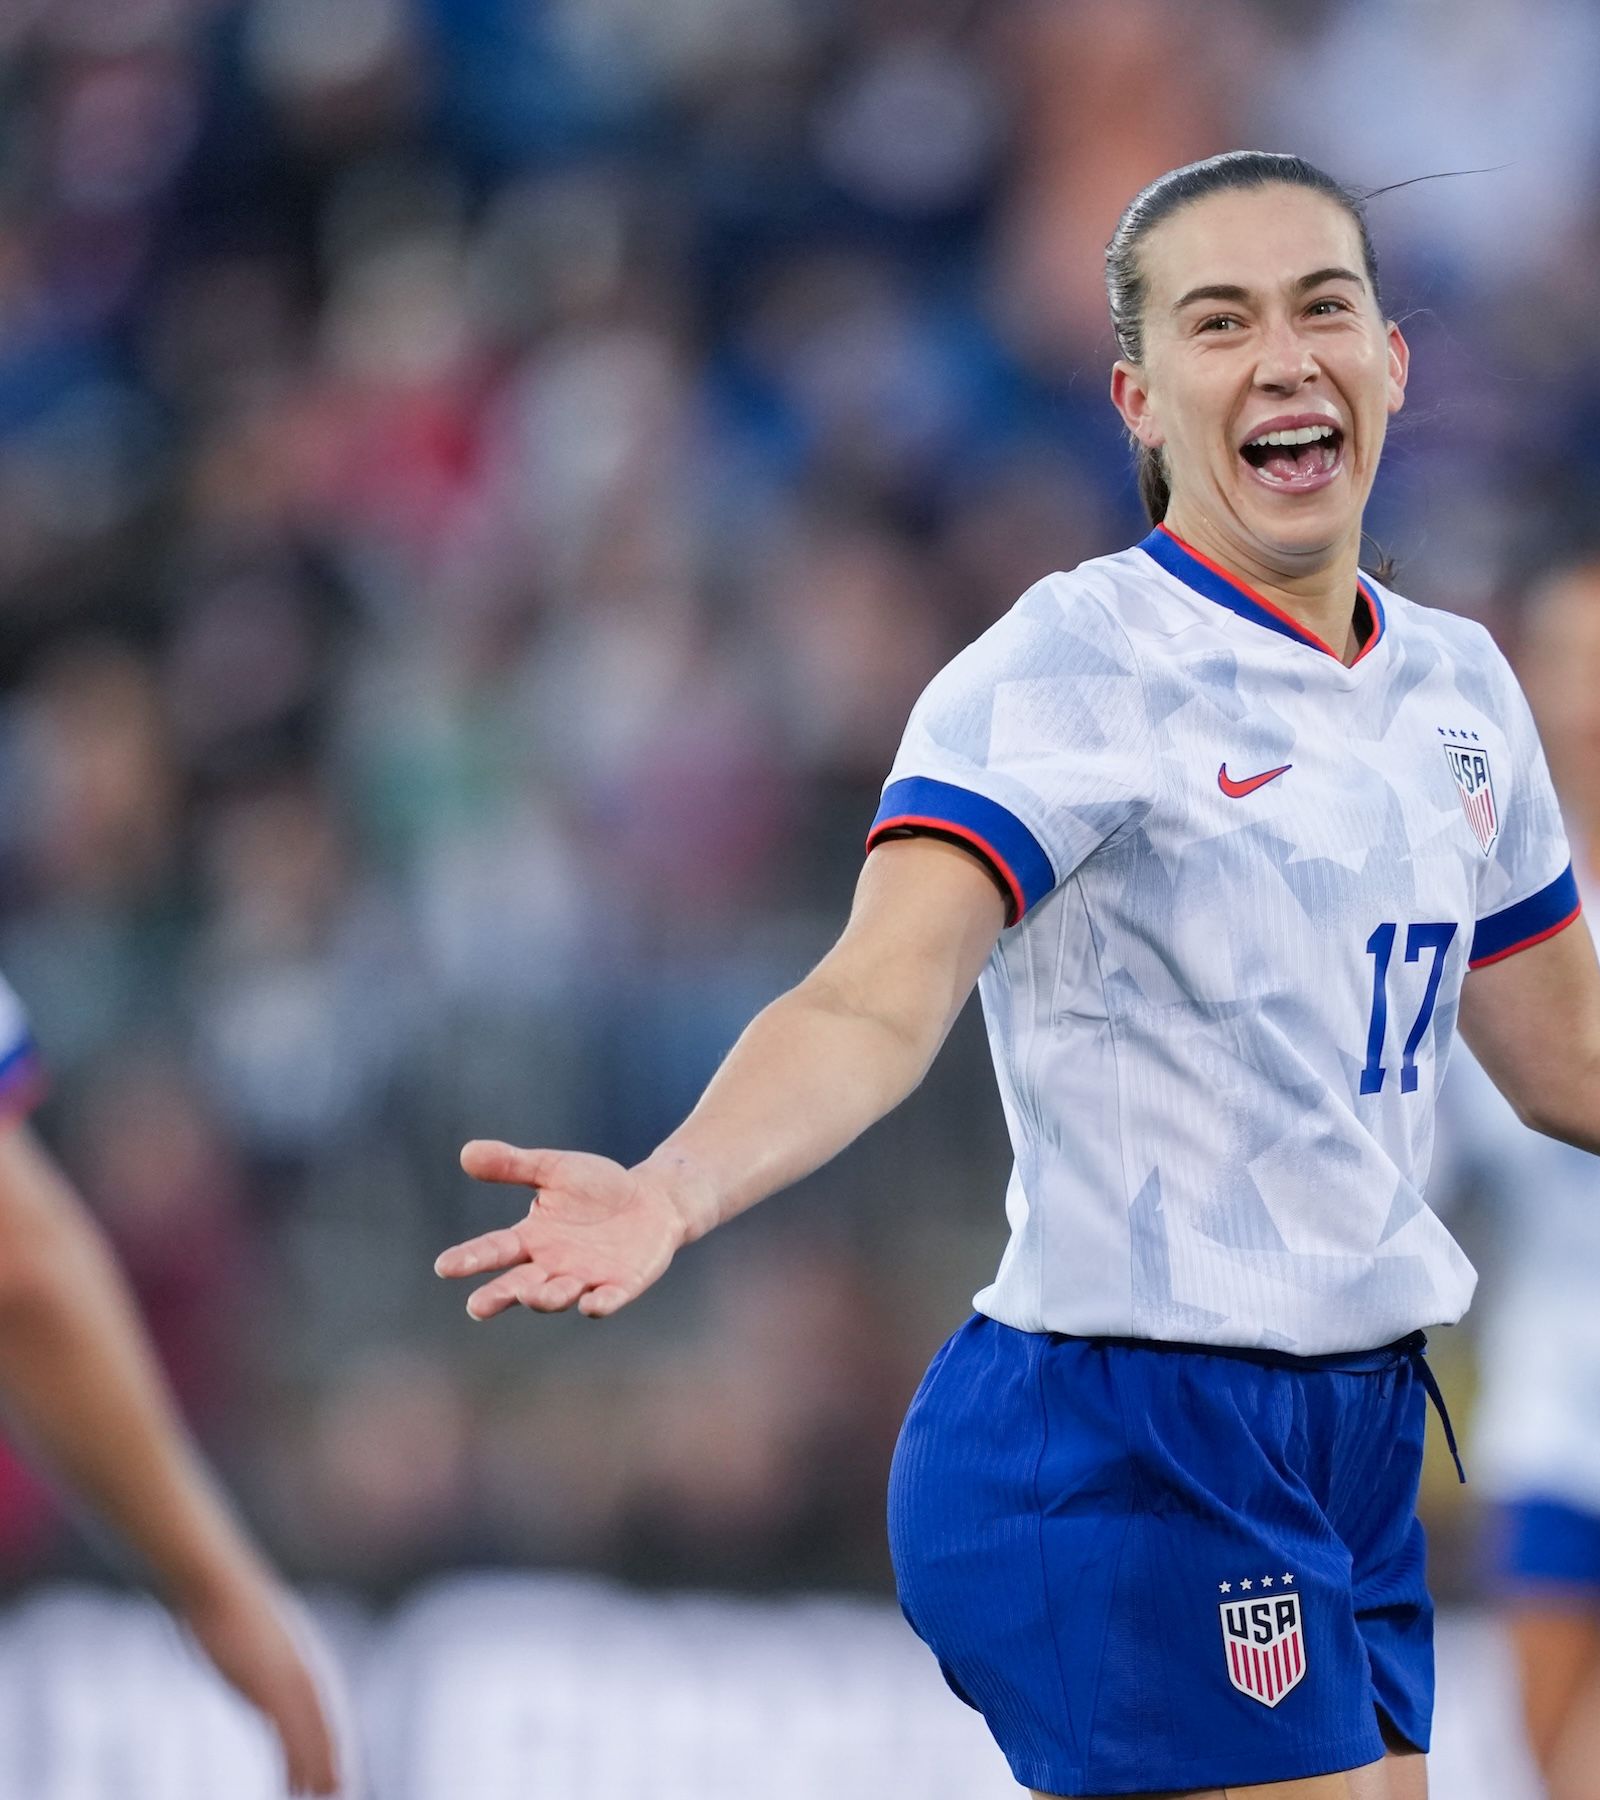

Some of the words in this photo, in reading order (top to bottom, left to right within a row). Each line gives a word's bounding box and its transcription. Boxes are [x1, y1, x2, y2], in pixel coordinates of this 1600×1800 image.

[1448, 751, 1487, 794] USA
[1359, 922, 1459, 1096] 17
[1226, 1600, 1296, 1645] USA
